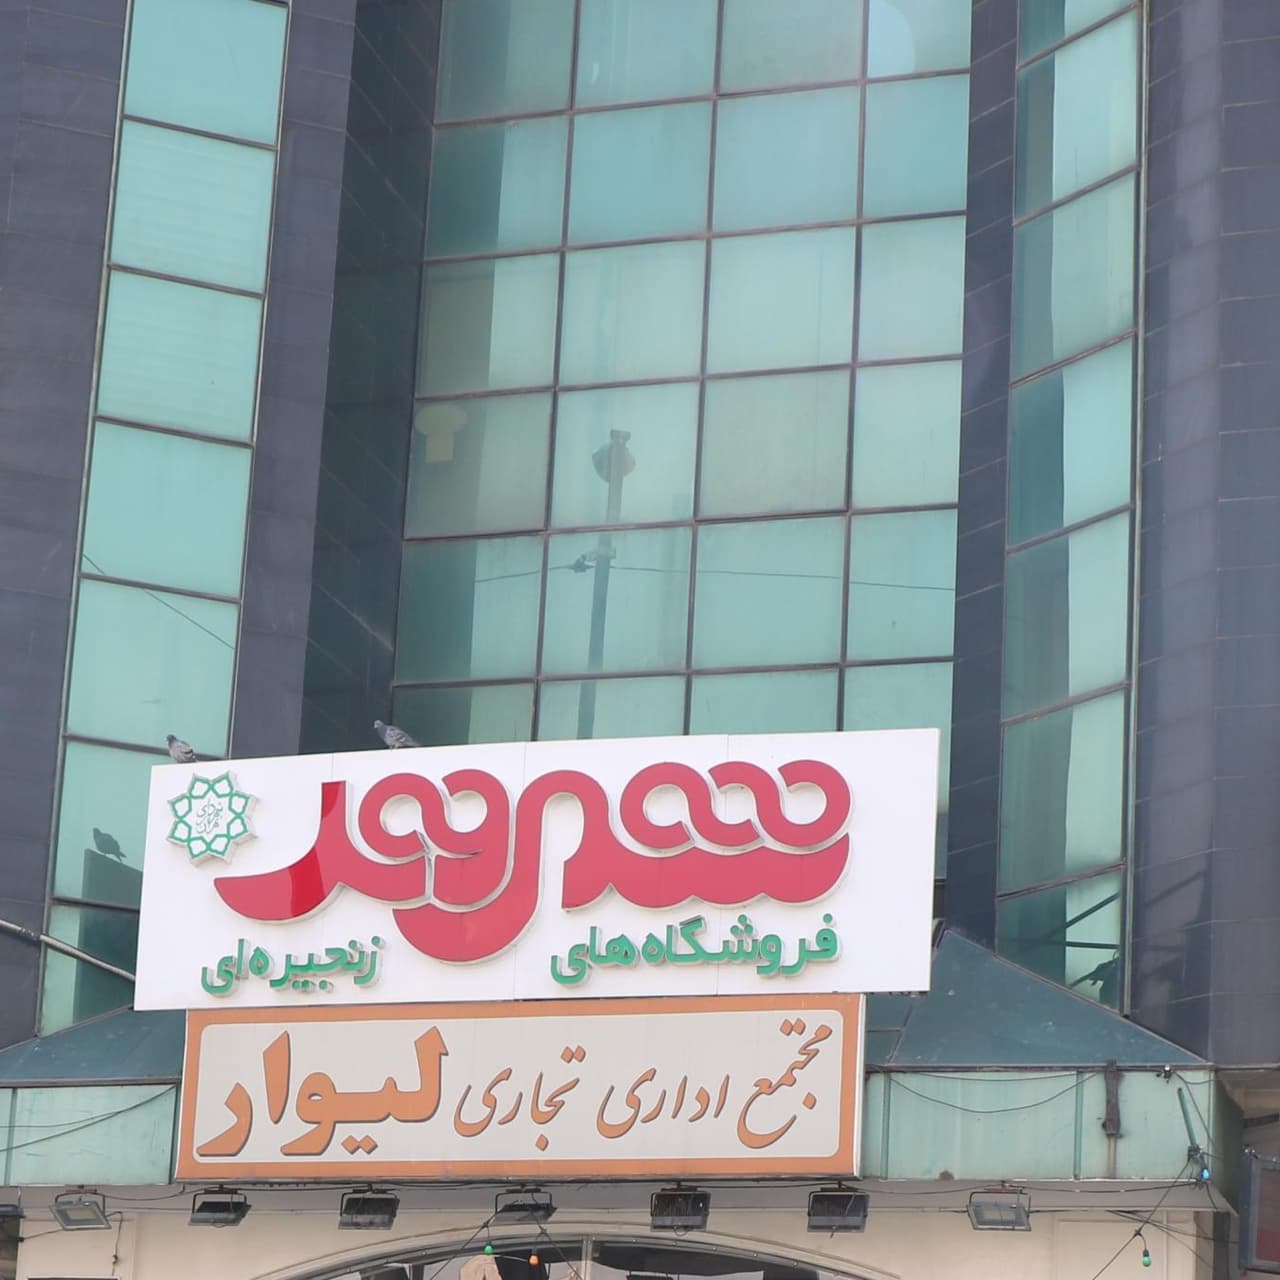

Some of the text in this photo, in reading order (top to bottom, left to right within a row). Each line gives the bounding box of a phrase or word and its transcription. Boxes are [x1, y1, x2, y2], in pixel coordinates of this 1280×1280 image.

[196, 1018, 833, 1158] مجتمع اداری تجاری لیوار
